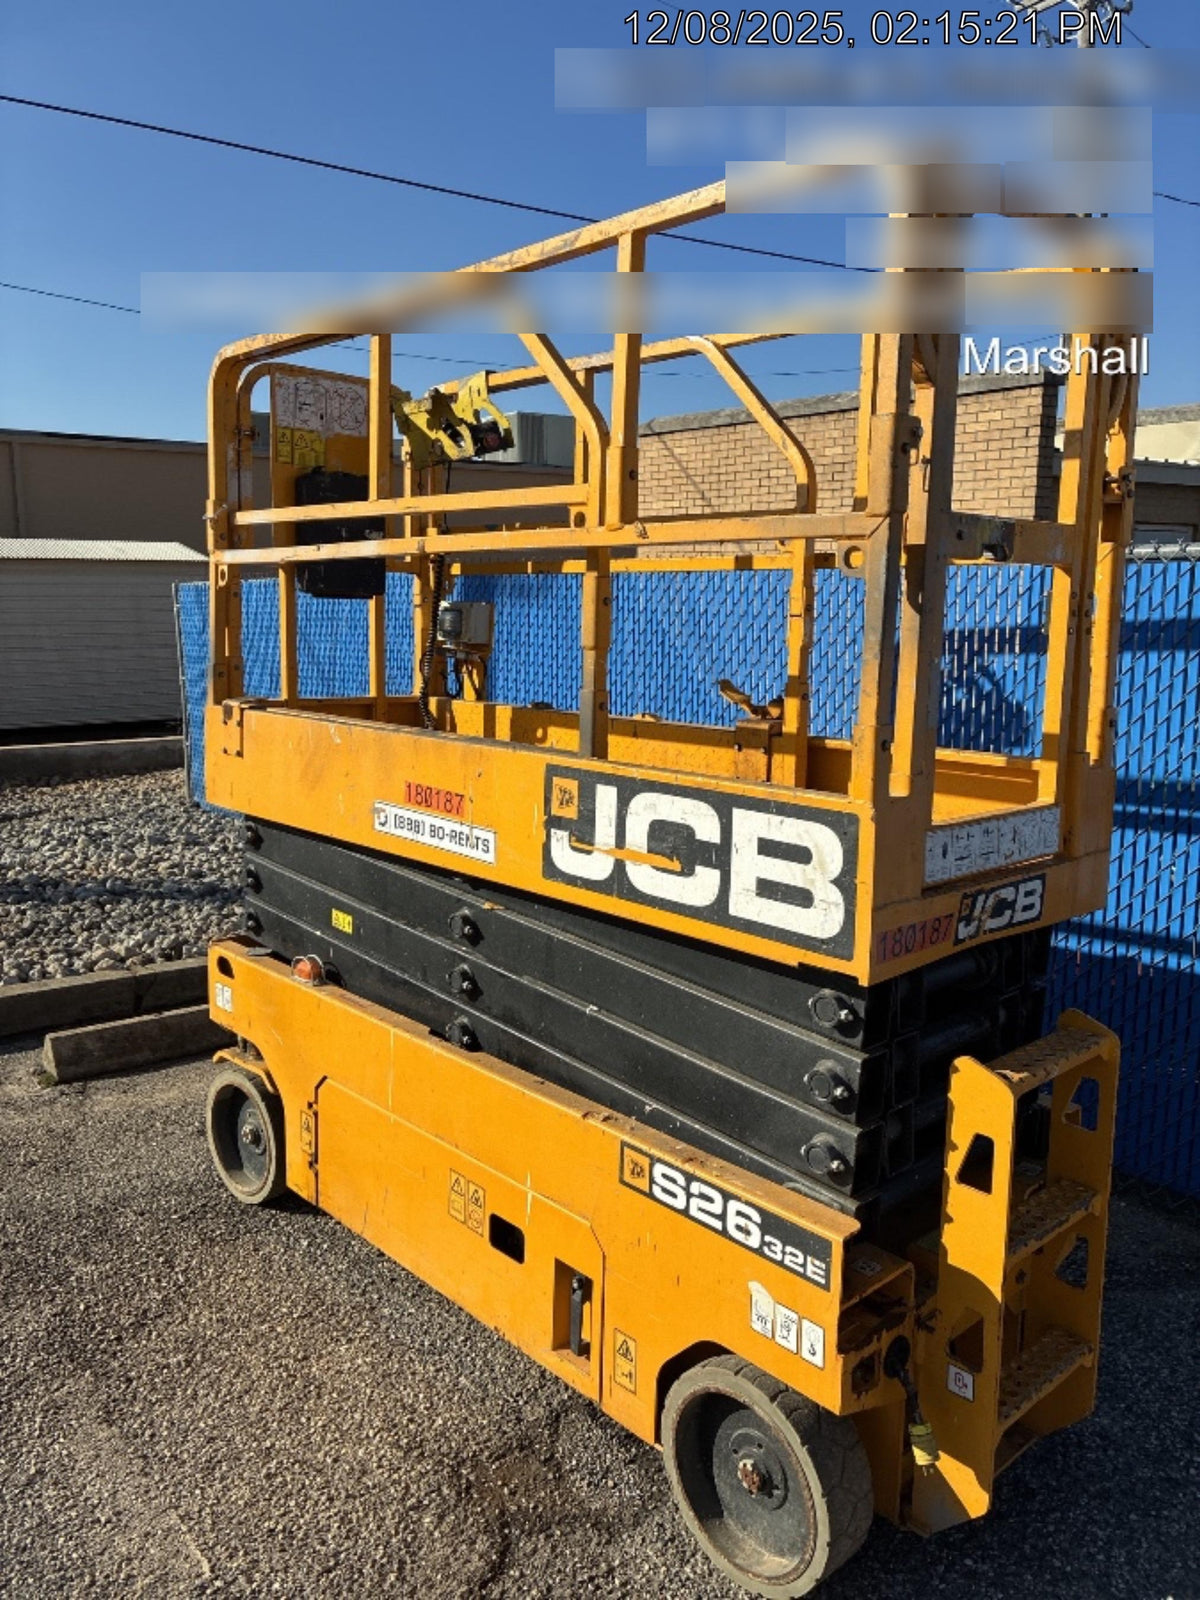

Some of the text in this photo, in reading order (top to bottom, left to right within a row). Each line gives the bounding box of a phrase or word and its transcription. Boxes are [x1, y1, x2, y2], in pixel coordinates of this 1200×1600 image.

[405, 781, 465, 815] 180187
[550, 783, 845, 940] JCB
[957, 879, 1044, 940] JCB
[879, 914, 954, 961] 180187
